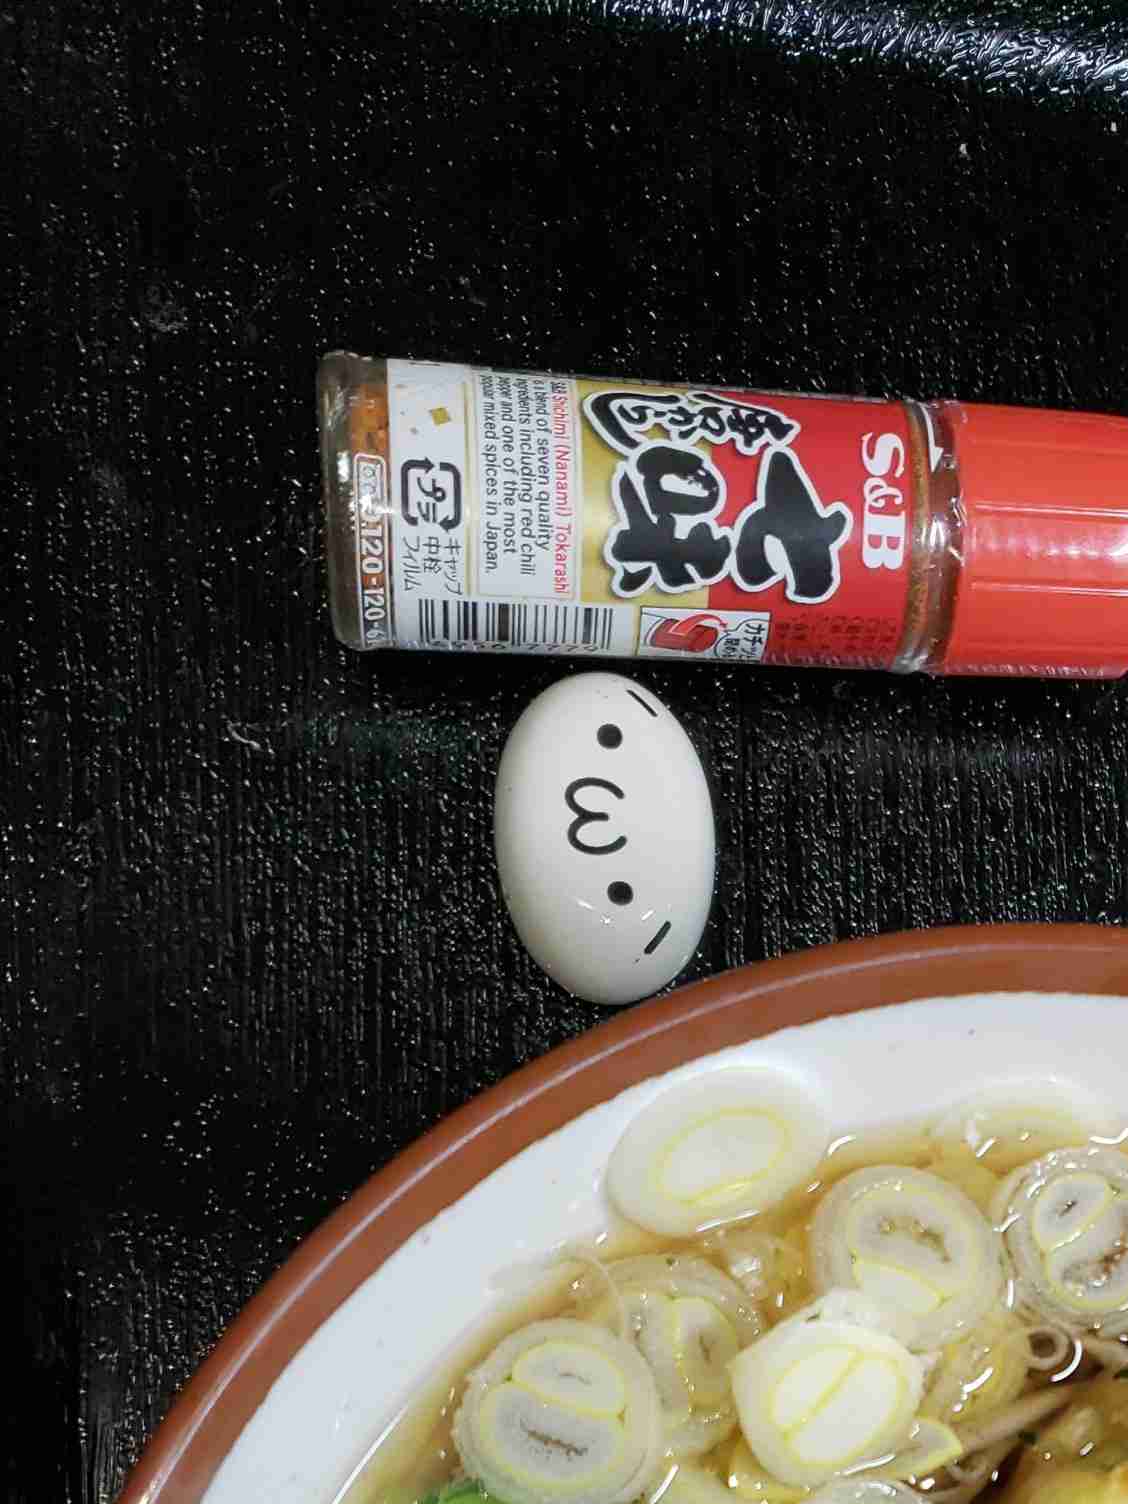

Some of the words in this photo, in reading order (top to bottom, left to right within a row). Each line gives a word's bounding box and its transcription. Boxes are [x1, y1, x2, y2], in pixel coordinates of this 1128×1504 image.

[483, 402, 500, 439] mixed
[500, 401, 516, 422] and
[534, 391, 550, 416] blend
[552, 395, 570, 439] Shichimi
[502, 425, 514, 453] one
[536, 419, 552, 433] of
[482, 444, 501, 496] spices
[503, 457, 519, 475] of
[517, 429, 537, 502] including
[537, 438, 550, 485] seven
[553, 444, 572, 517] (Nanami)
[416, 476, 447, 524] プラ
[486, 501, 501, 516] in
[503, 480, 519, 506] the
[861, 431, 905, 569] S&B
[503, 512, 517, 553] most
[521, 508, 536, 538] red
[534, 490, 554, 551] quality
[611, 447, 847, 600] 七味
[402, 536, 422, 592] フィルム
[422, 536, 443, 574] 中栓
[444, 537, 464, 596] キャップ
[483, 521, 501, 574] Japan.
[520, 543, 536, 576] chili
[553, 523, 572, 593] Tokarashi
